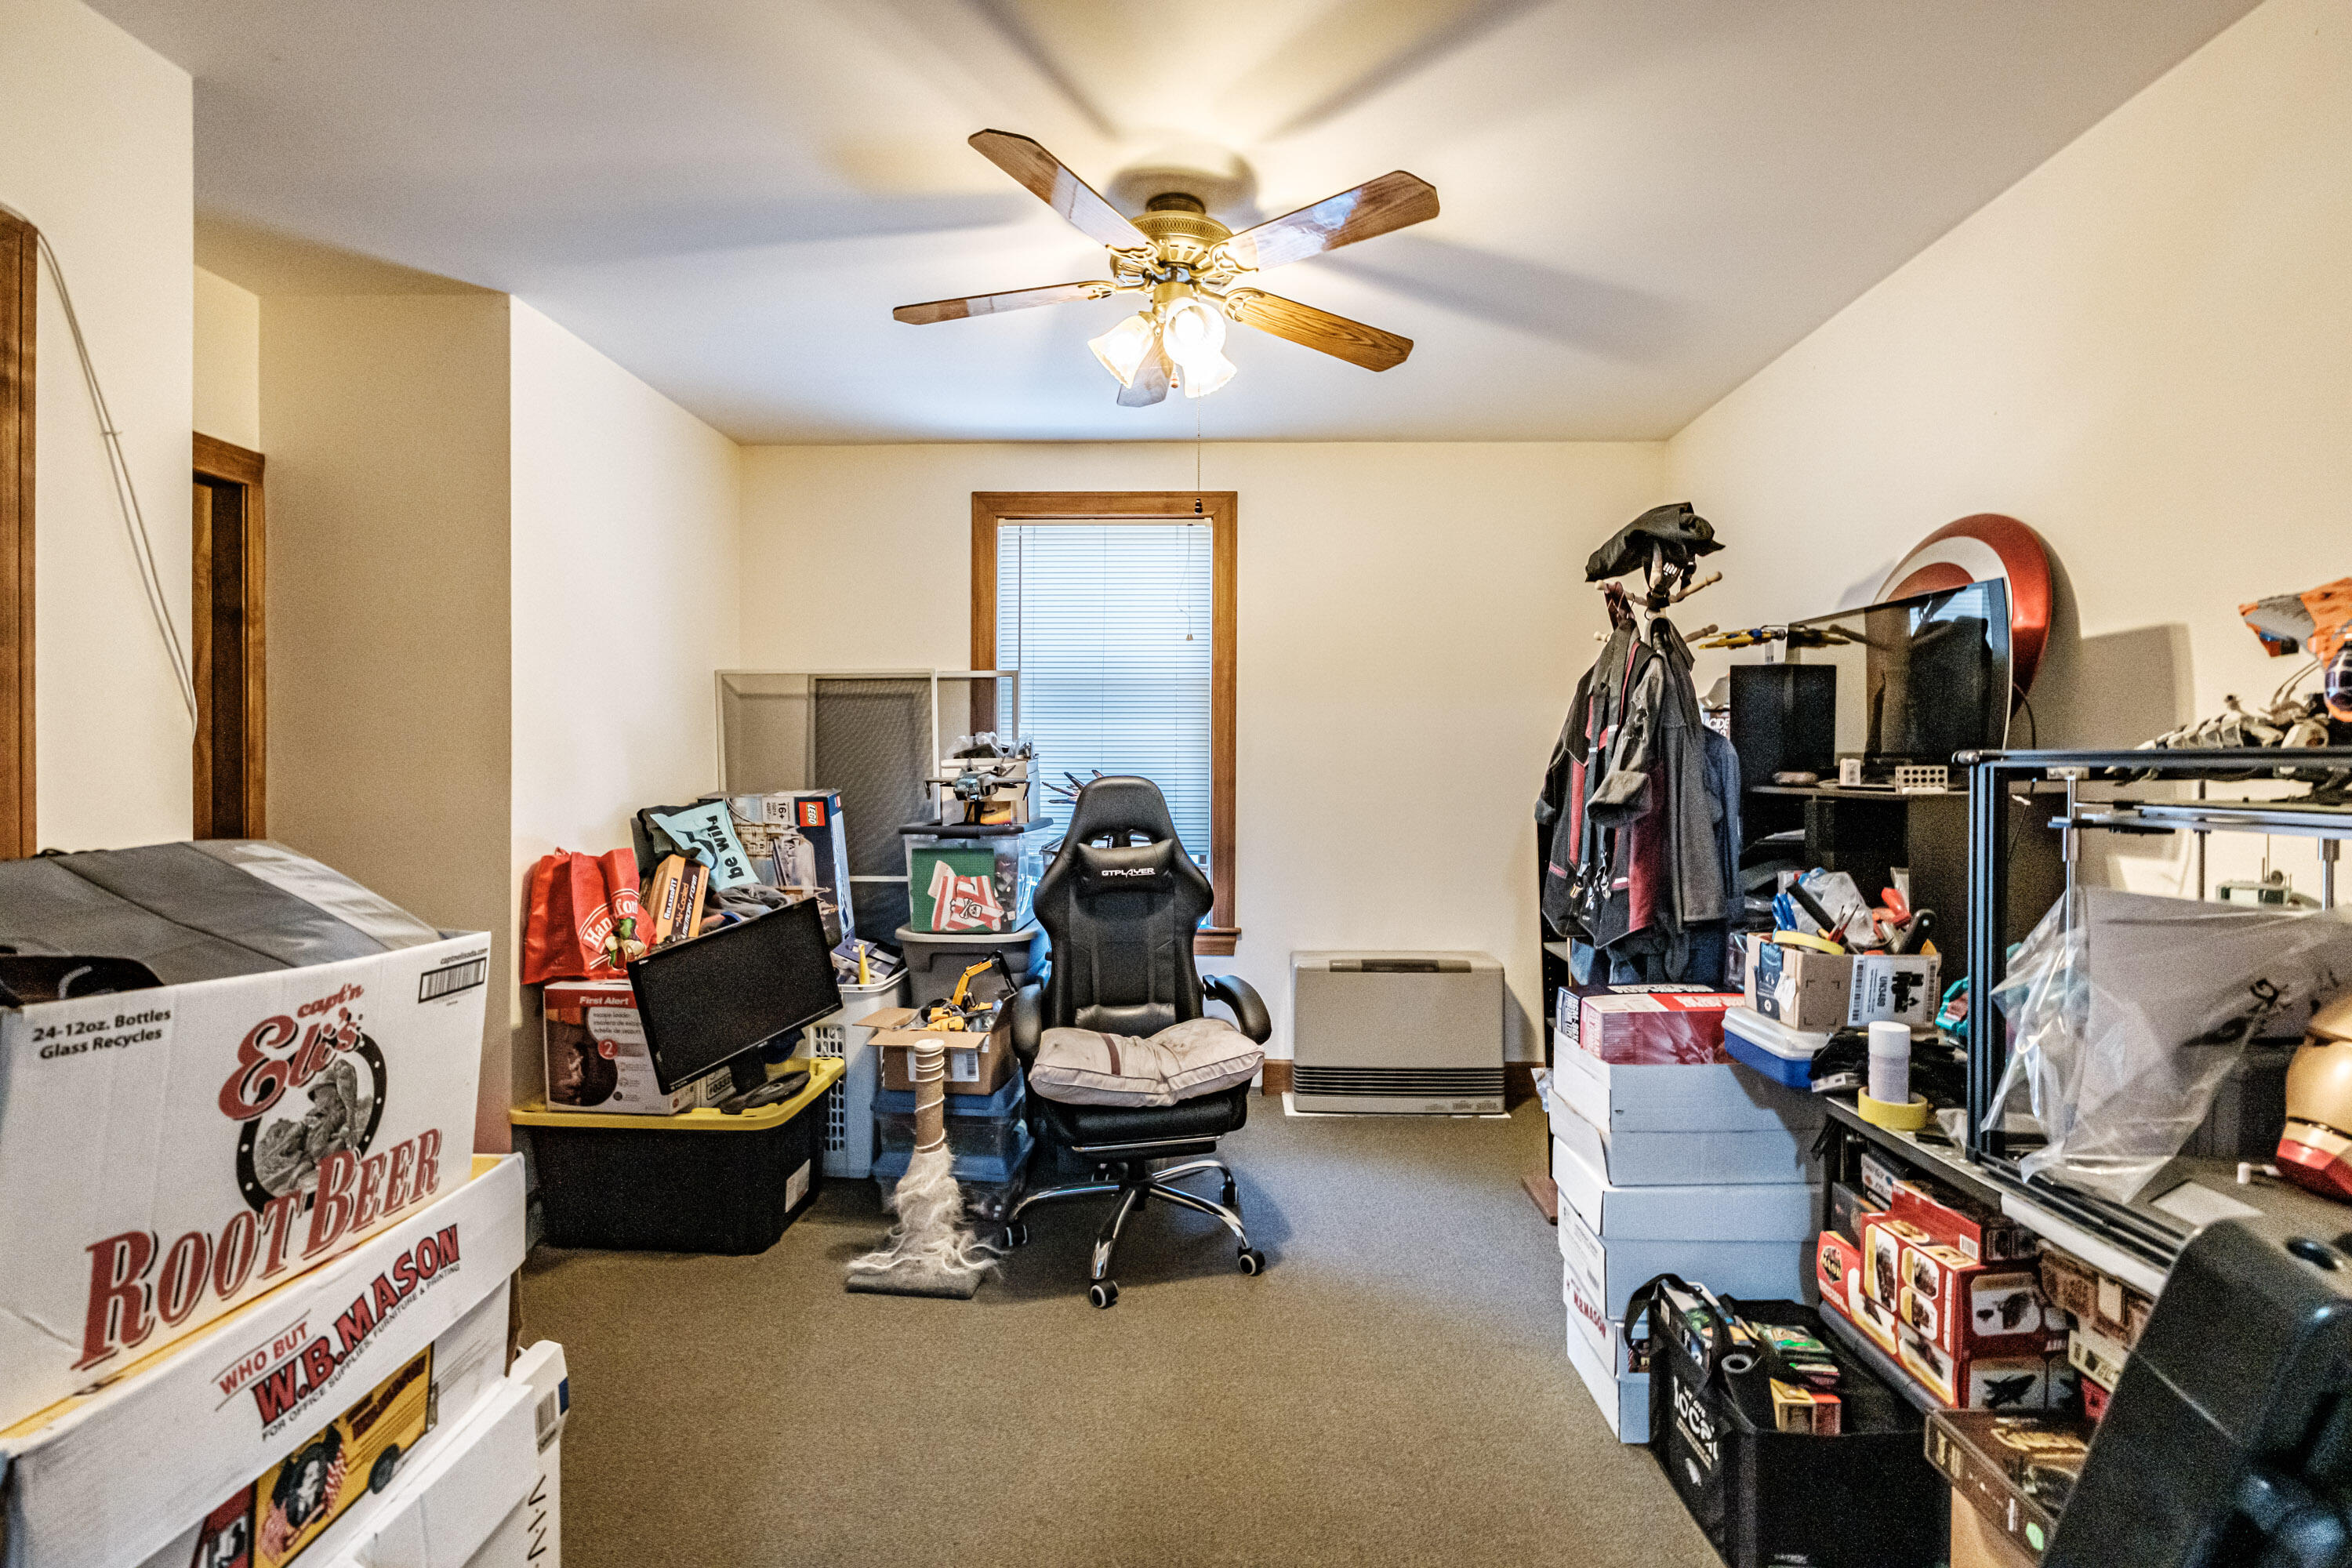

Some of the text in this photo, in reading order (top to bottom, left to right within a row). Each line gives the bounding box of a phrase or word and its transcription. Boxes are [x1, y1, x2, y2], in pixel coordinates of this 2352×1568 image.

[806, 803, 817, 826] LEGO
[724, 856, 744, 880] be
[1102, 868, 1156, 878] GTPLAYER
[682, 899, 693, 937] MEMORY
[297, 983, 364, 1018] capt'n
[579, 996, 629, 1005] First Alert
[31, 1010, 171, 1042] 24-12oz. Bottles
[40, 1028, 162, 1059] Glass Recycles
[604, 1041, 612, 1054] 2
[219, 1007, 361, 1121] Eli's
[71, 1127, 442, 1371] ROOT BEER
[220, 1322, 307, 1395] WHO BUT
[263, 1419, 286, 1443] FOR
[289, 1386, 327, 1422] OFFICE
[373, 1294, 418, 1338] FURNITURE
[419, 1287, 426, 1296] &
[426, 1263, 460, 1290] PRINTING
